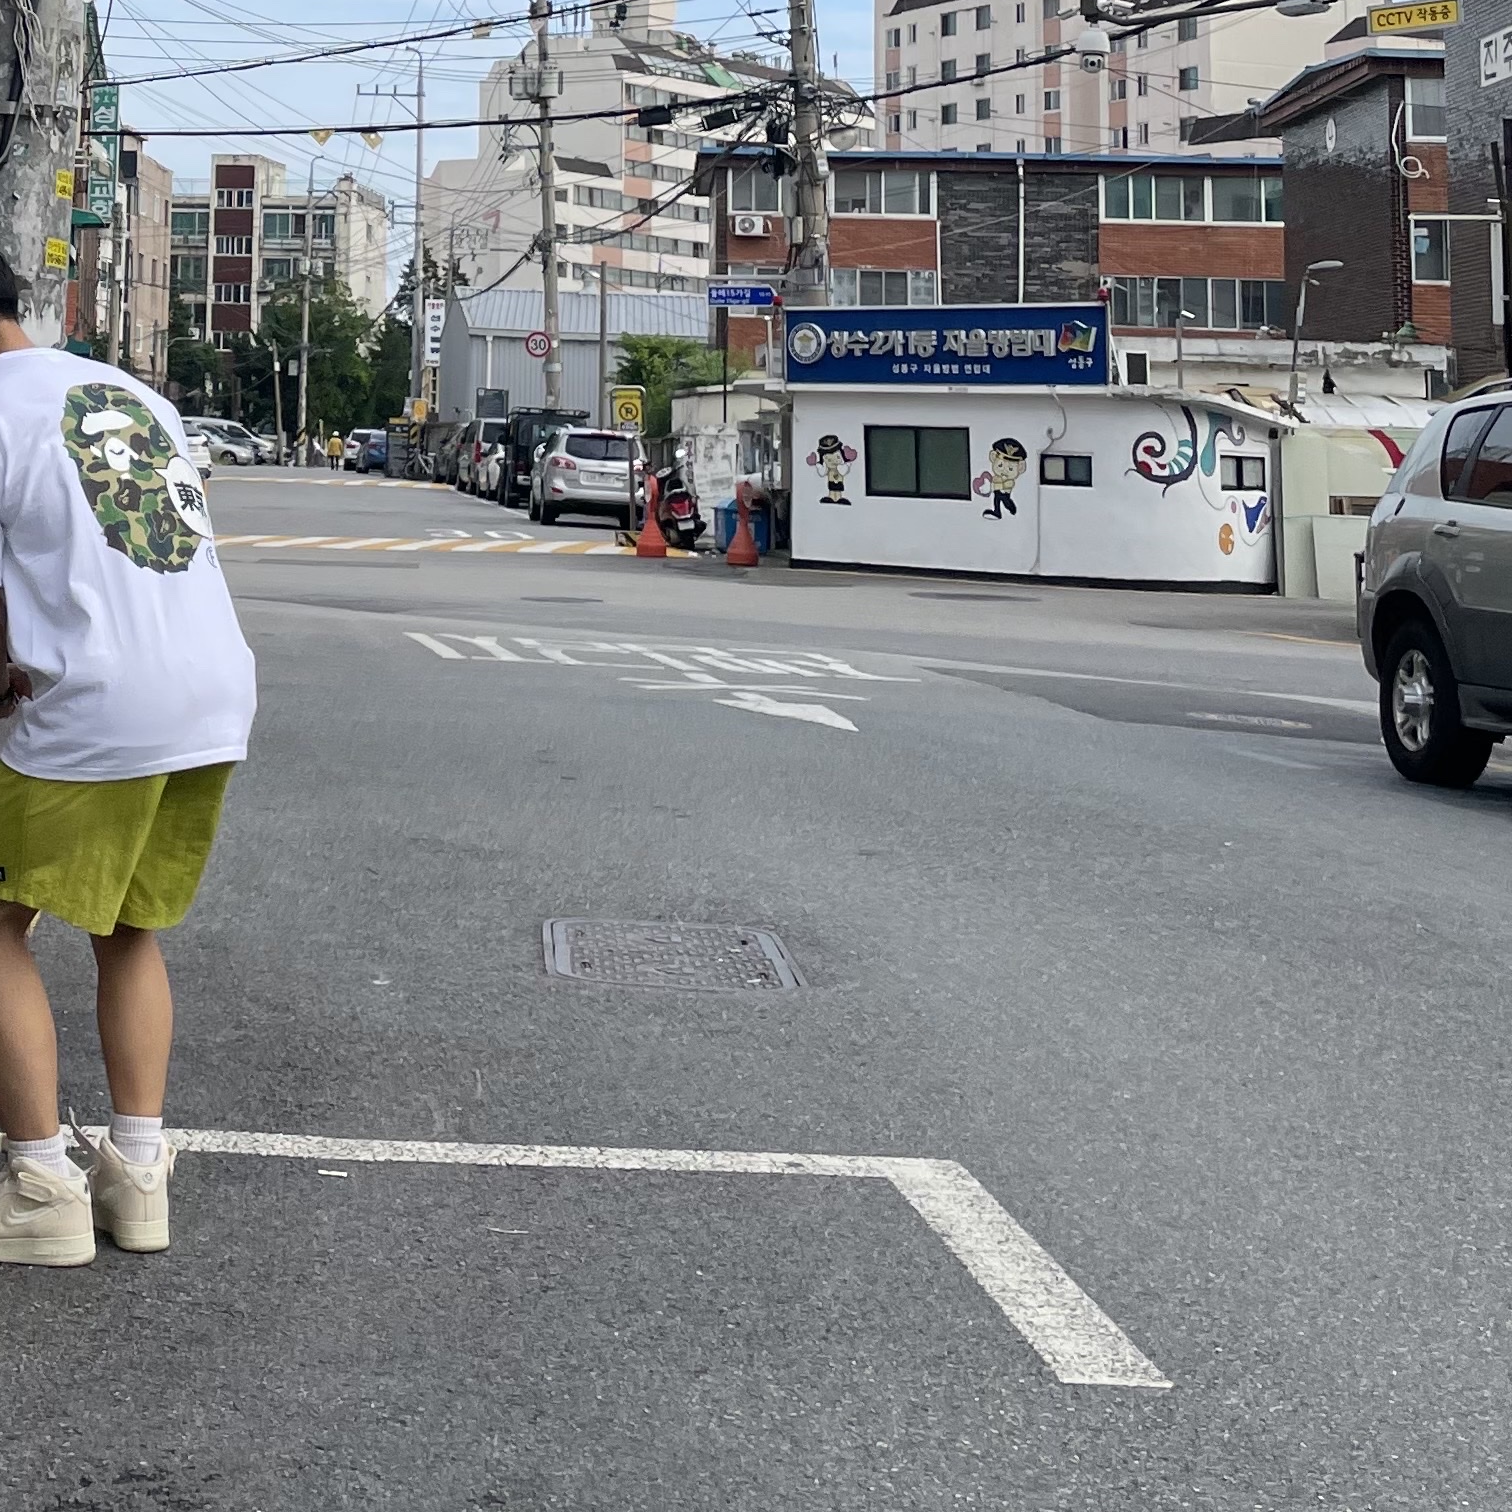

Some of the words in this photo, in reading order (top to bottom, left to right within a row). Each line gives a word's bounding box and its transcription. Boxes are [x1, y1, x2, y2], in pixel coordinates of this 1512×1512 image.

[1377, 10, 1413, 27] CCTV
[1417, 5, 1451, 22] 작동중
[530, 338, 546, 351] 30
[827, 330, 937, 359] 성수2가1동
[943, 328, 1057, 358] 자율방범대
[892, 363, 918, 374] 성동구
[1068, 355, 1093, 369] 성동구
